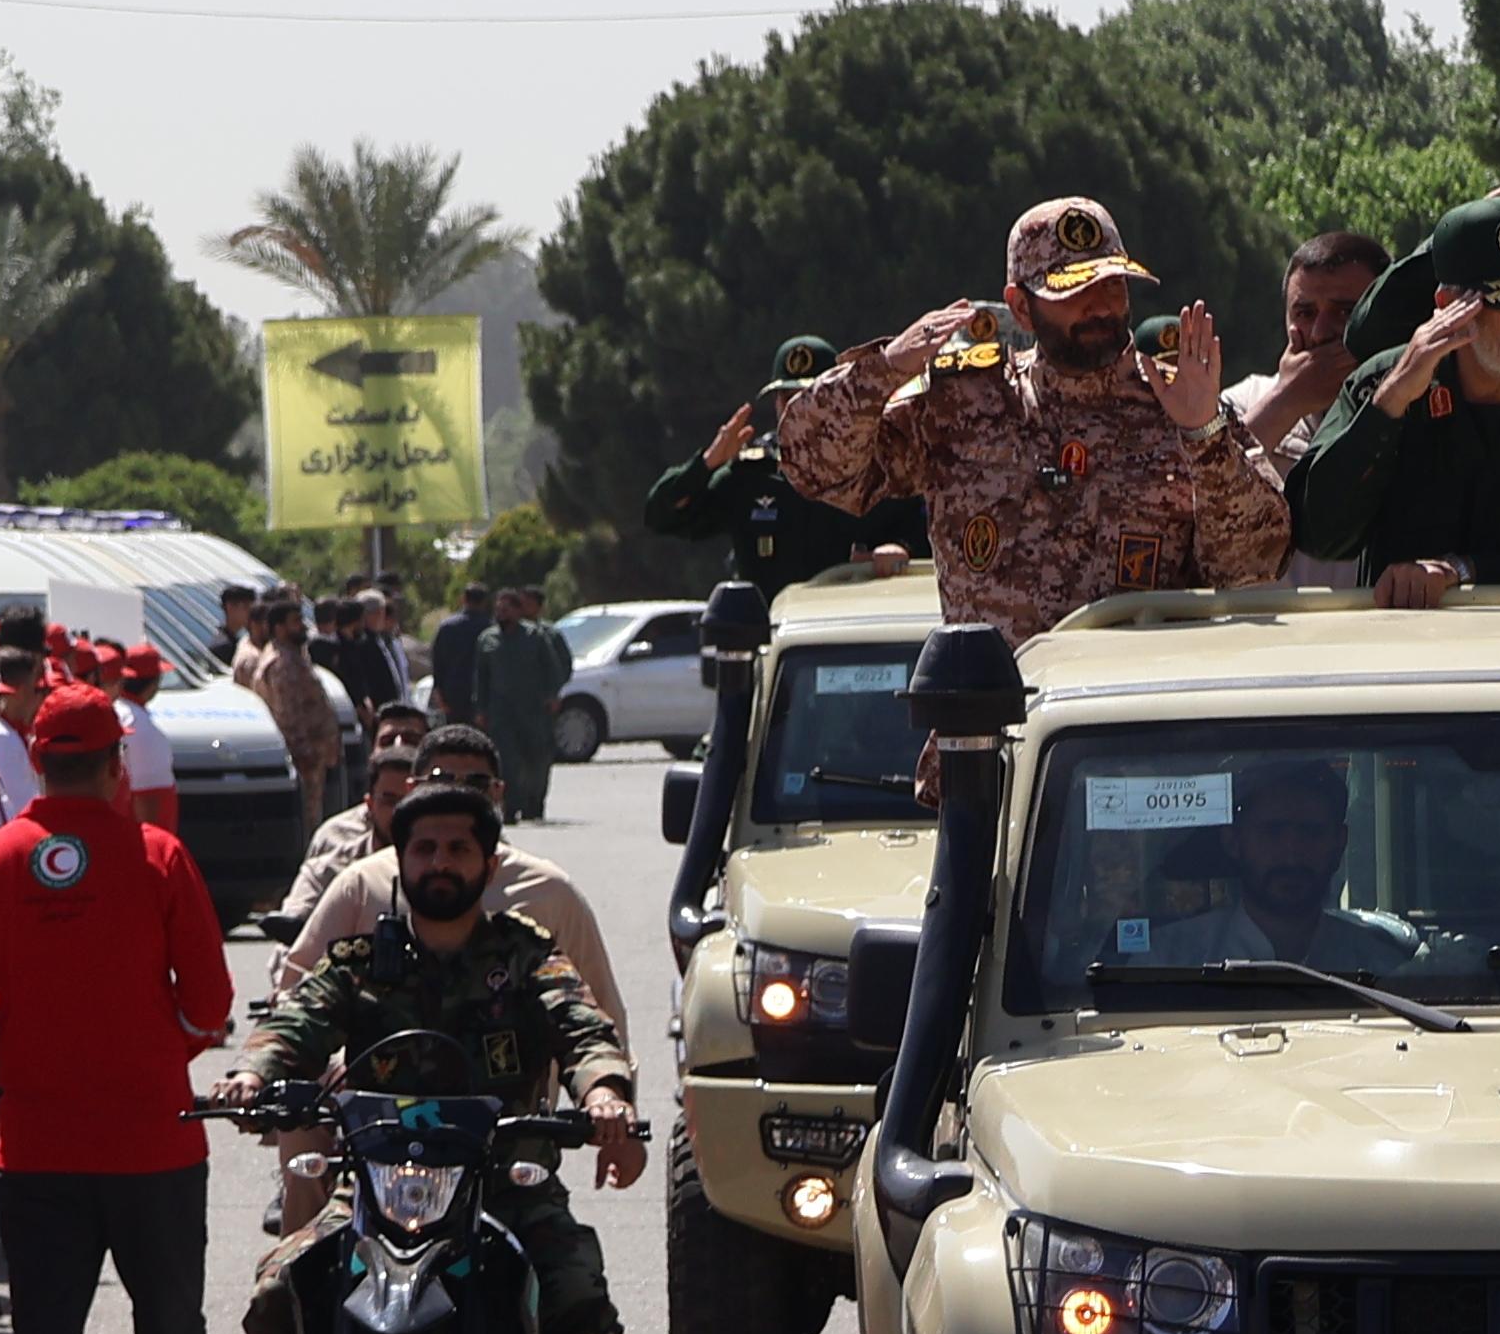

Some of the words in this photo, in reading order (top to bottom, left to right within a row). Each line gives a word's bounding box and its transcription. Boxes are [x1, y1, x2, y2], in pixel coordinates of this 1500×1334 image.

[326, 402, 392, 426] سمت
[395, 404, 421, 432] به
[301, 438, 388, 475] برگزاری
[392, 440, 450, 470] محل
[336, 479, 418, 514] مراسم
[1146, 792, 1208, 810] 00195
